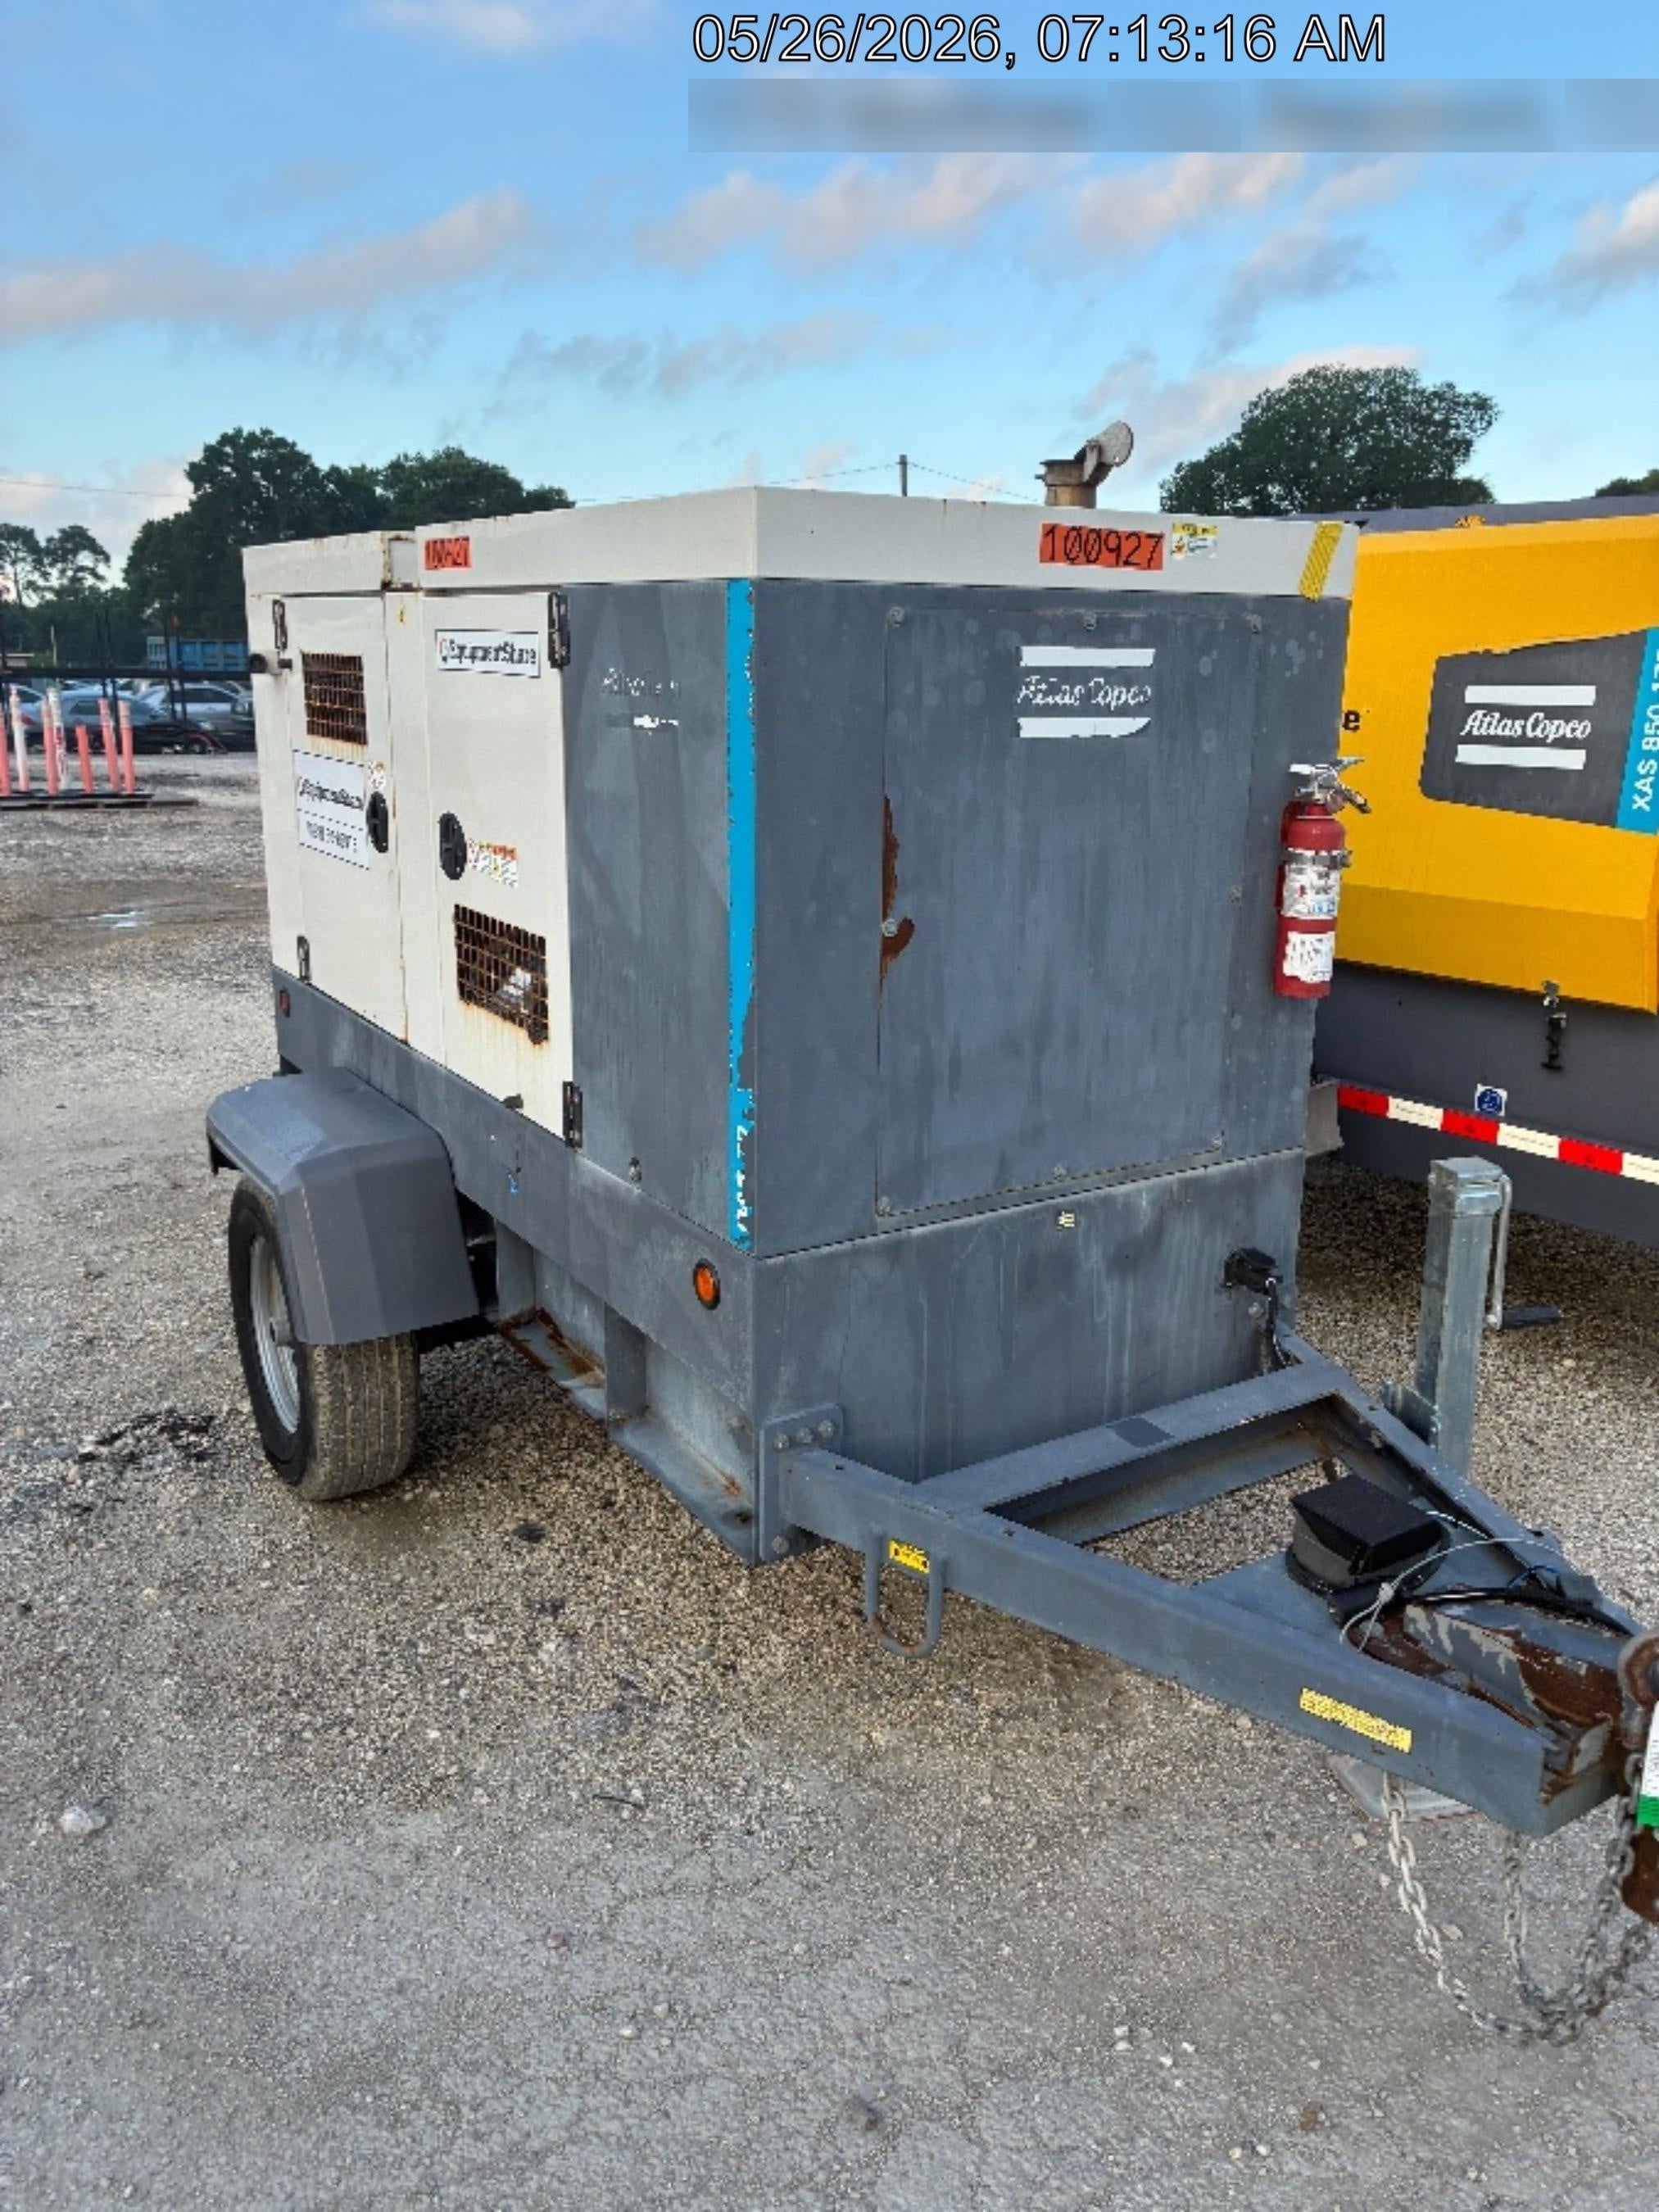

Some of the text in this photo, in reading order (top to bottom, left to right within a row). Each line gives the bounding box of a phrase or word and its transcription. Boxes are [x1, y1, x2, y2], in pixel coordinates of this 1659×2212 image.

[1045, 525, 1165, 569] 100927
[1460, 709, 1592, 744] Atlas Copco
[1632, 758, 1658, 812] XAS
